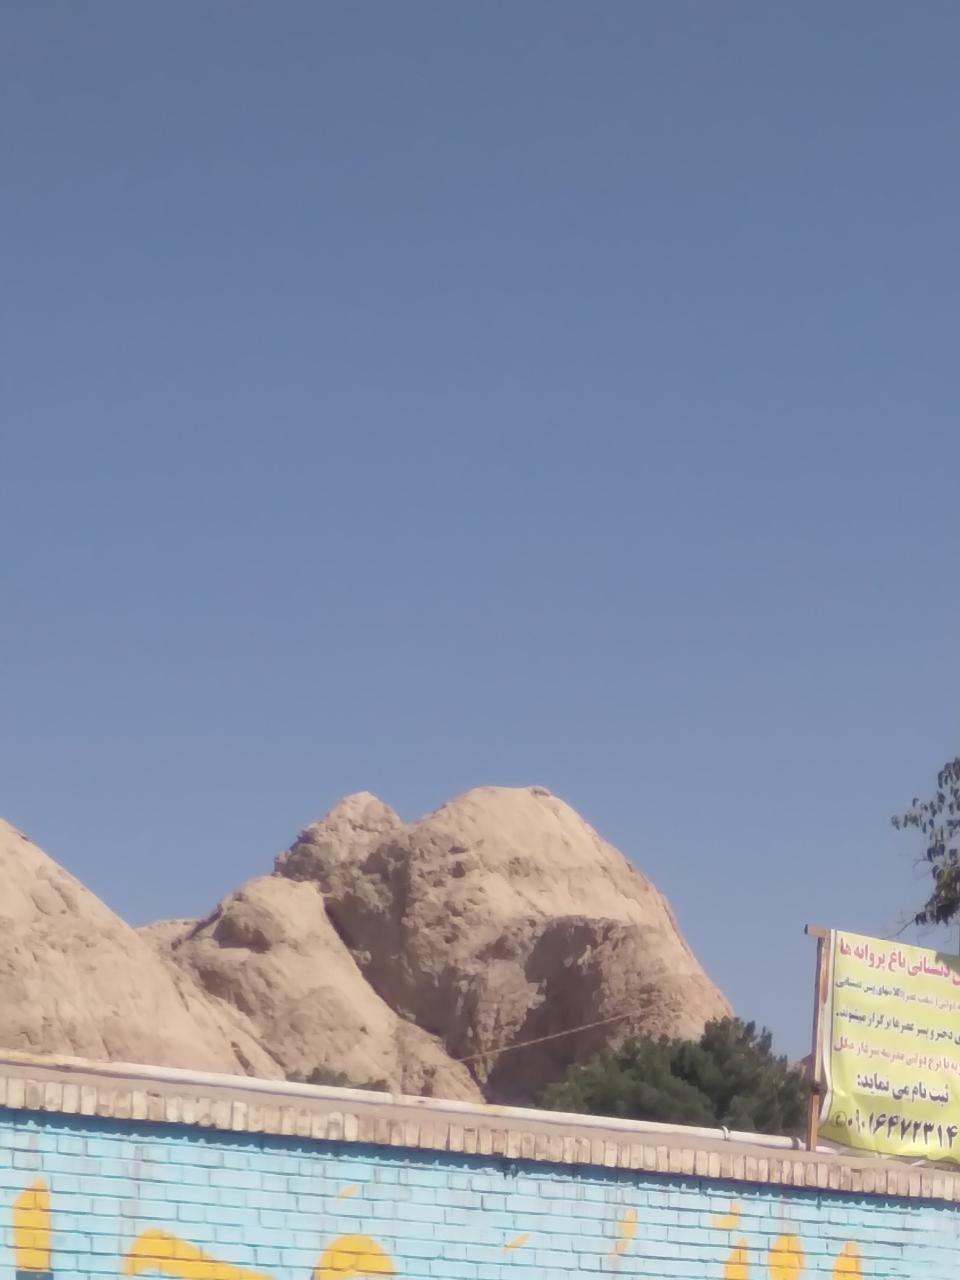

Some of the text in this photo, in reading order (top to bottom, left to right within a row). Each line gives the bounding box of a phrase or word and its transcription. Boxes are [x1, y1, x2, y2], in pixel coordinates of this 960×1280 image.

[854, 942, 885, 969] پروانه
[888, 948, 905, 973] باغ
[908, 954, 949, 981] دبستانی
[892, 1083, 909, 1102] می
[912, 1080, 926, 1104] نام
